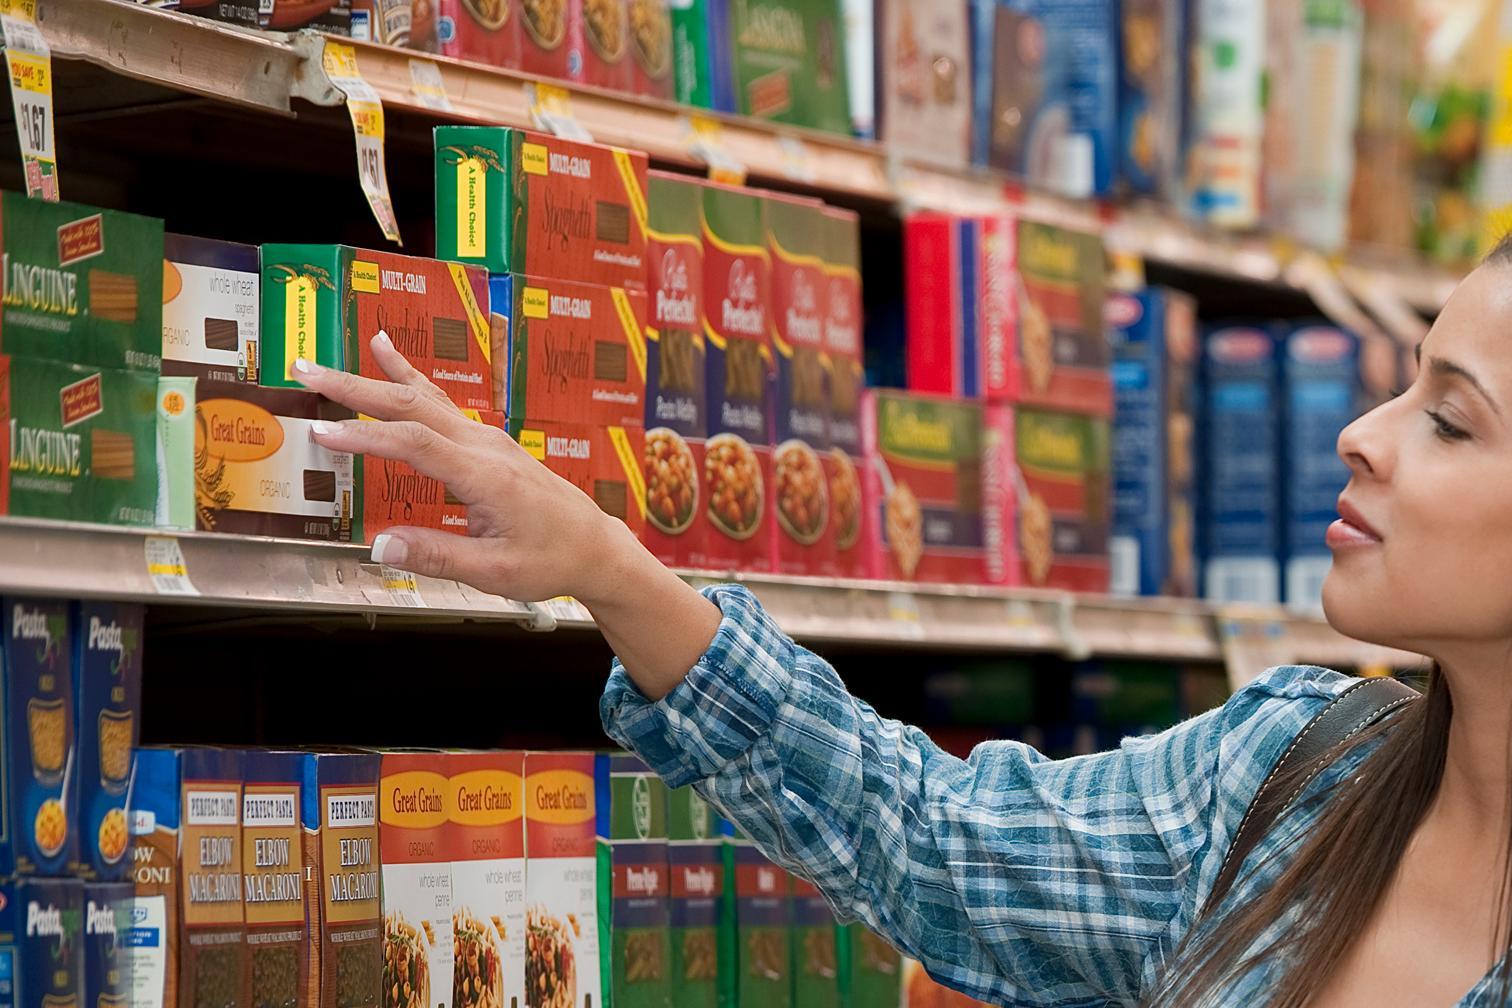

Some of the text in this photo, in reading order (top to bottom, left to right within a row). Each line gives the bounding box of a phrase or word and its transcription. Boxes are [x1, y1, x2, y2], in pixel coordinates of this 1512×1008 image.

[549, 152, 592, 179] MULTI-GRAIN
[467, 177, 476, 214] Health
[2, 252, 78, 317] LINGUINE
[209, 271, 255, 298] whole wheat
[381, 269, 427, 295] MULTI-GRAIN
[298, 295, 307, 329] Health
[550, 294, 592, 320] MULTI-GRAIN
[163, 325, 191, 347] RGANIC
[297, 330, 306, 360] Choic
[210, 413, 265, 446] Great Grains
[10, 417, 82, 478] LINGUINE
[546, 436, 591, 460] MULTI-GRAIN
[259, 479, 291, 499] ORGANIC
[12, 604, 50, 640] Pasta
[88, 615, 123, 650] Pasta
[191, 797, 220, 817] PERFECT
[246, 799, 293, 820] PERFECT PASTA
[330, 799, 375, 821] PERFECT PASTA
[392, 786, 443, 814] Great Grains
[457, 784, 512, 812] Great Grains
[535, 784, 587, 811] Great Grains
[200, 836, 234, 867] ELBOW
[255, 838, 290, 867] ELBOW
[340, 837, 372, 867] ELBOW
[408, 841, 434, 857] ORGANIC
[471, 839, 500, 855] ORGANIC
[189, 872, 242, 903] MACARONI
[244, 872, 302, 903] MACARONI
[330, 872, 378, 903] MACARONI
[418, 872, 436, 889] whole
[484, 869, 522, 884] whole wheat
[26, 899, 63, 937] Pasta
[86, 900, 117, 935] Pasta
